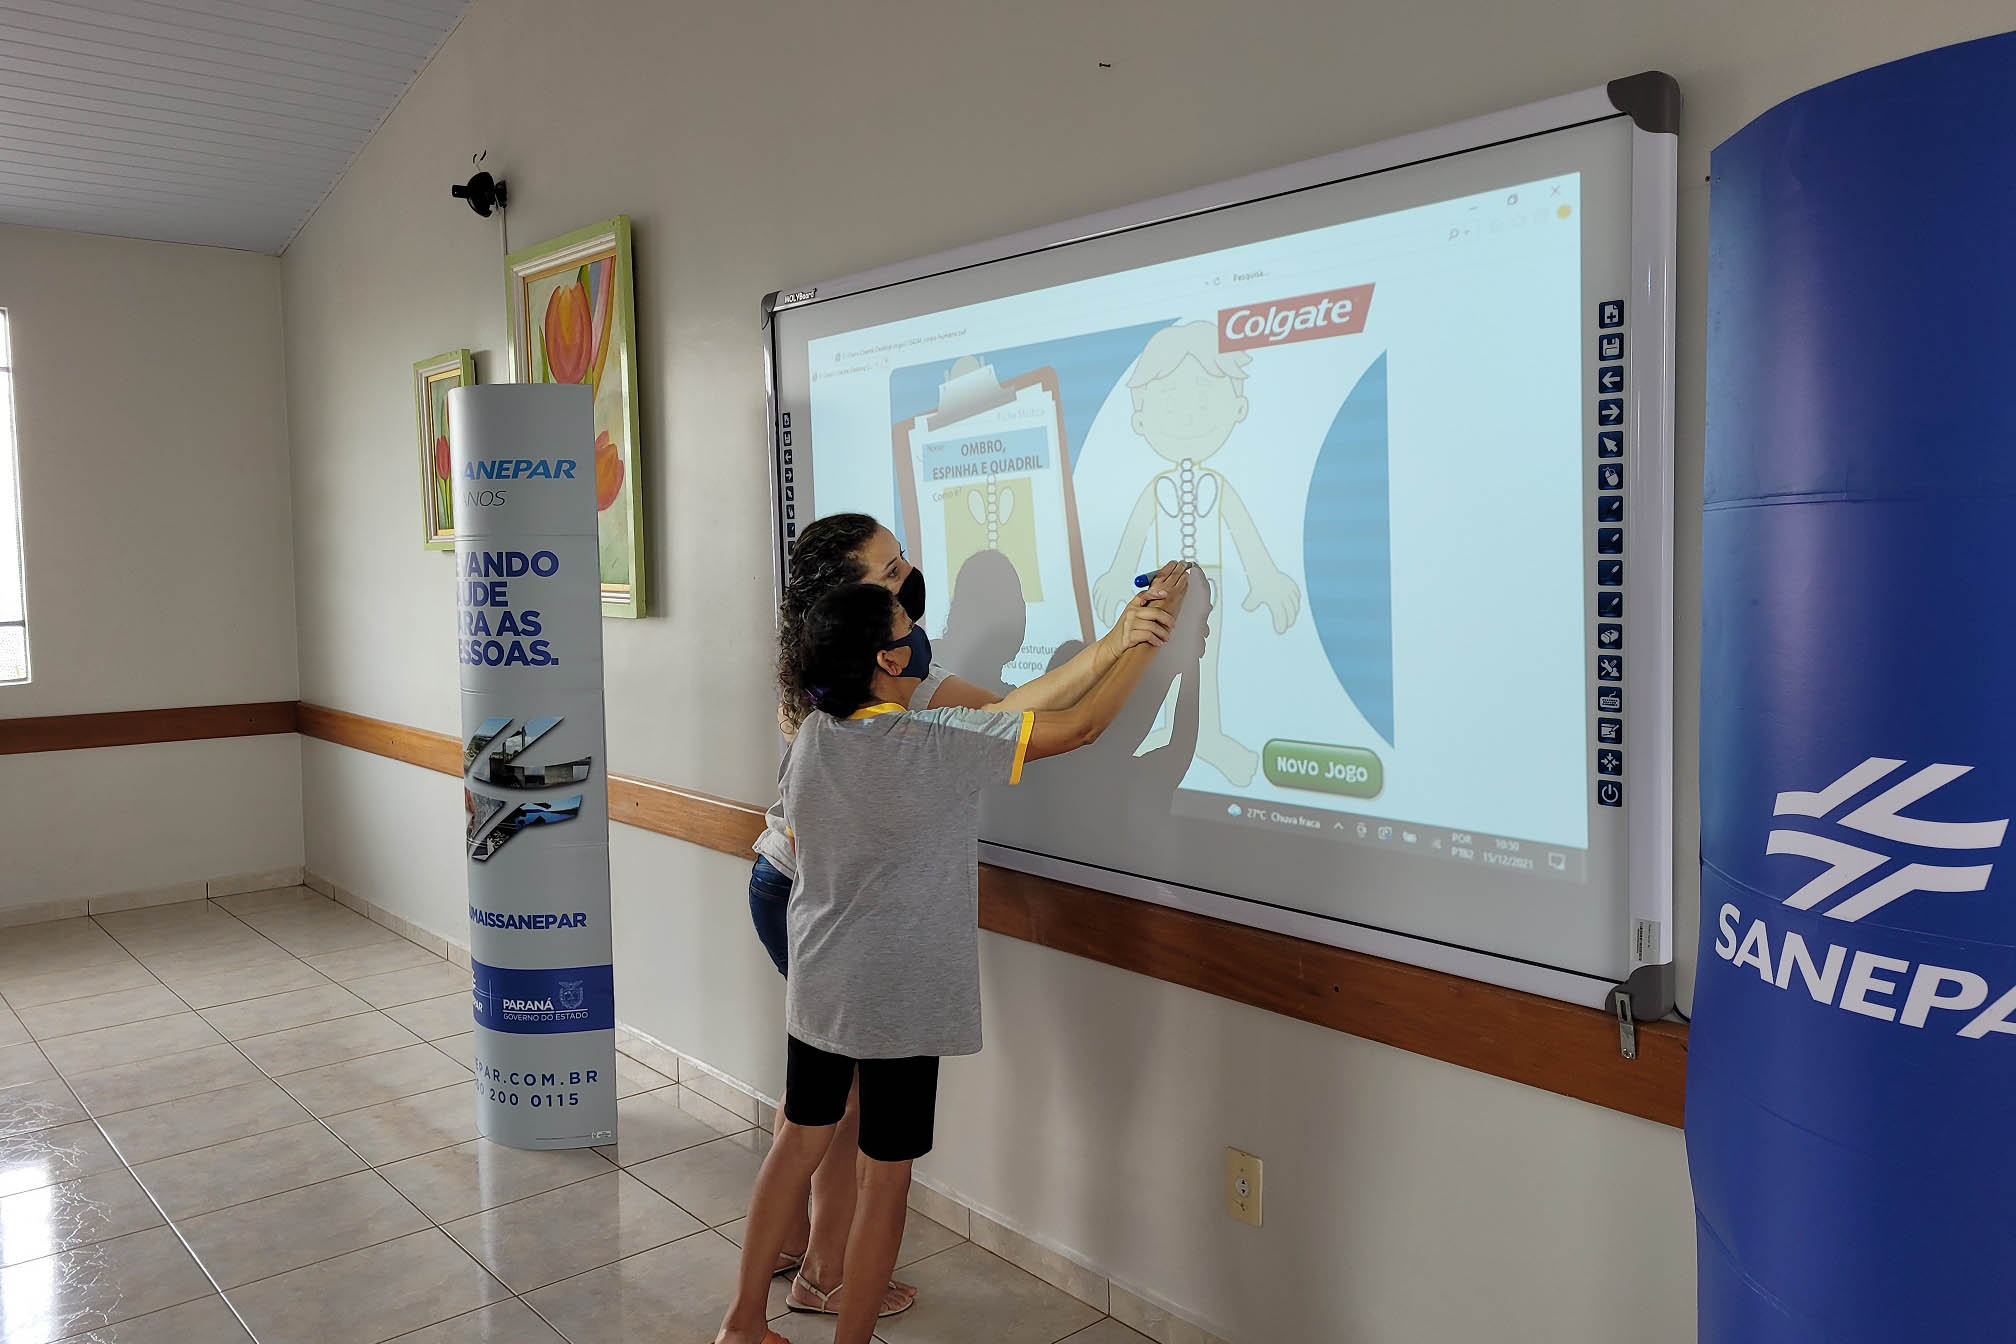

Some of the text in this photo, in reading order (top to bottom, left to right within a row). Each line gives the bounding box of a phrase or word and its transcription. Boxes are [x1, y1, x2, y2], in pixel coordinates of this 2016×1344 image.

[1225, 298, 1353, 341] Colgate
[961, 440, 1006, 457] OMBRO,
[932, 456, 1042, 481] ESPINHA E QUADRIL
[464, 490, 507, 507] NOS
[496, 610, 542, 637] AS
[1021, 645, 1055, 656] estrutur
[1270, 812, 1298, 825] Chuva
[1299, 816, 1321, 829] fraca
[1451, 832, 1472, 845] POR
[503, 998, 554, 1011] PARANÁ
[503, 1011, 589, 1022] GOVERNO DO ESTADO
[489, 1088, 519, 1106] 200
[530, 1093, 580, 1108] 0115
